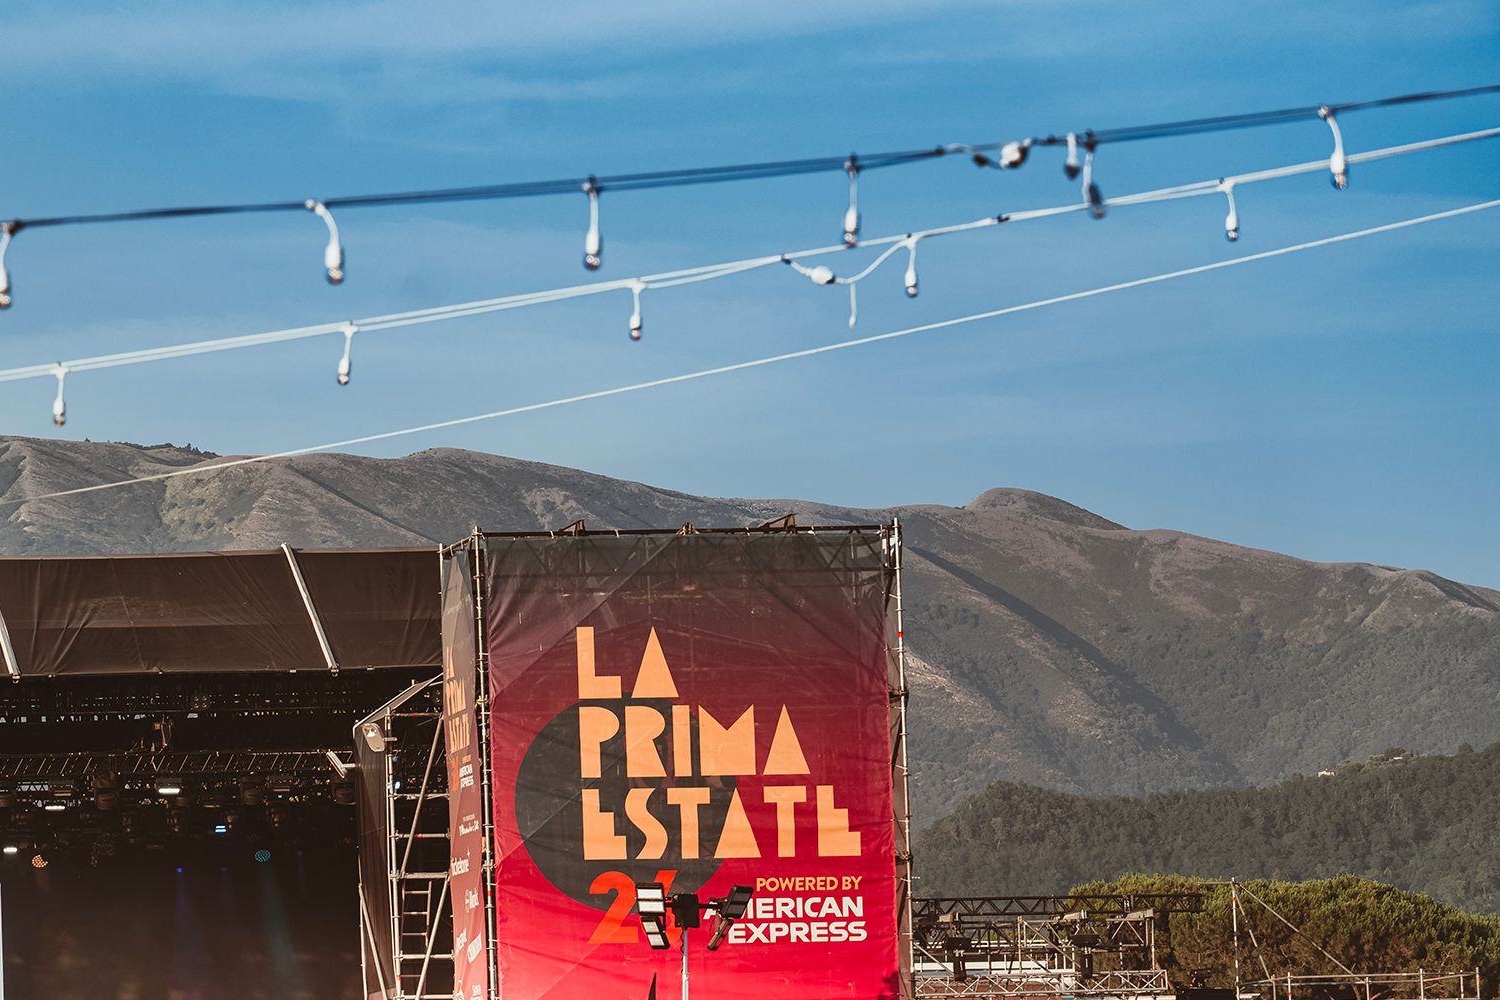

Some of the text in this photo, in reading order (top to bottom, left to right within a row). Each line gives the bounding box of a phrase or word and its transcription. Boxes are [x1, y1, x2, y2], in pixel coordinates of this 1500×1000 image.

[576, 626, 679, 699] LA
[579, 704, 811, 778] PRIMA
[582, 785, 862, 860] ESTATE
[756, 876, 863, 892] POWERED BY
[728, 921, 868, 944] EXPRESS
